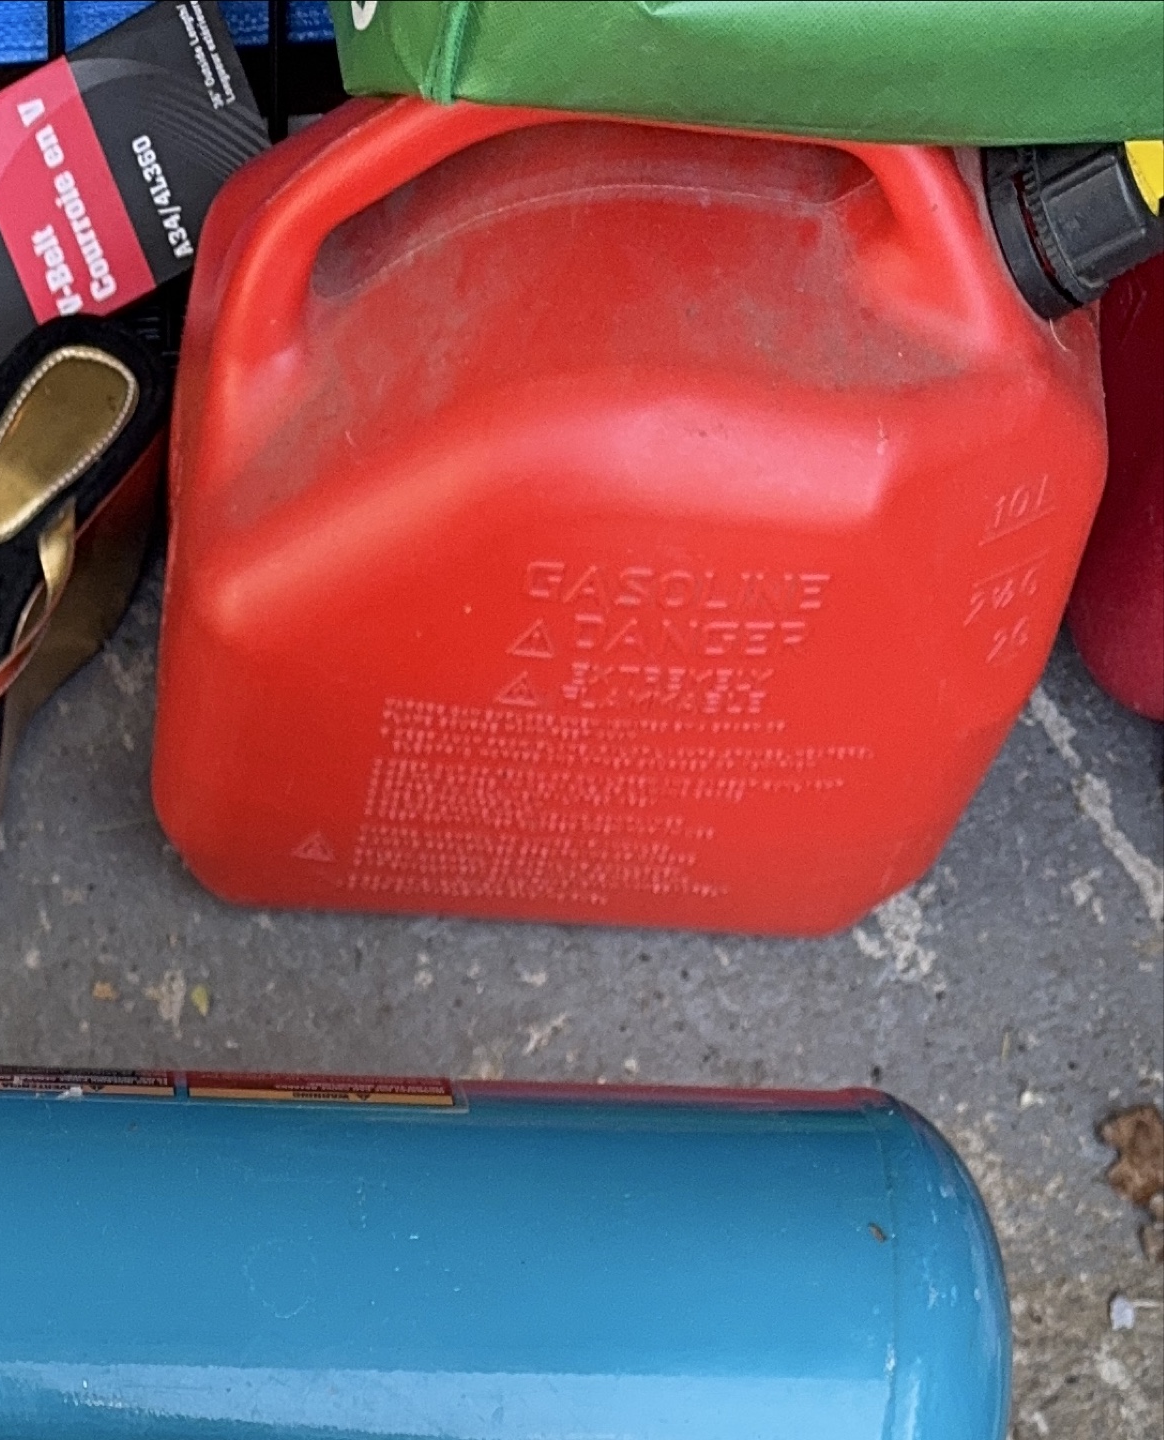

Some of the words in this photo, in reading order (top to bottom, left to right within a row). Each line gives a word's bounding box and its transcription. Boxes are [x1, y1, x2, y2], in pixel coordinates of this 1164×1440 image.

[194, 45, 215, 88] Outside
[210, 53, 236, 104] Longueur
[17, 98, 45, 128] V
[36, 125, 64, 169] en
[132, 135, 194, 259] A34/4L360
[55, 170, 117, 302] Courroie
[31, 224, 83, 316] V-Belt
[527, 562, 830, 609] GASOLINE
[575, 613, 806, 655] DANGER
